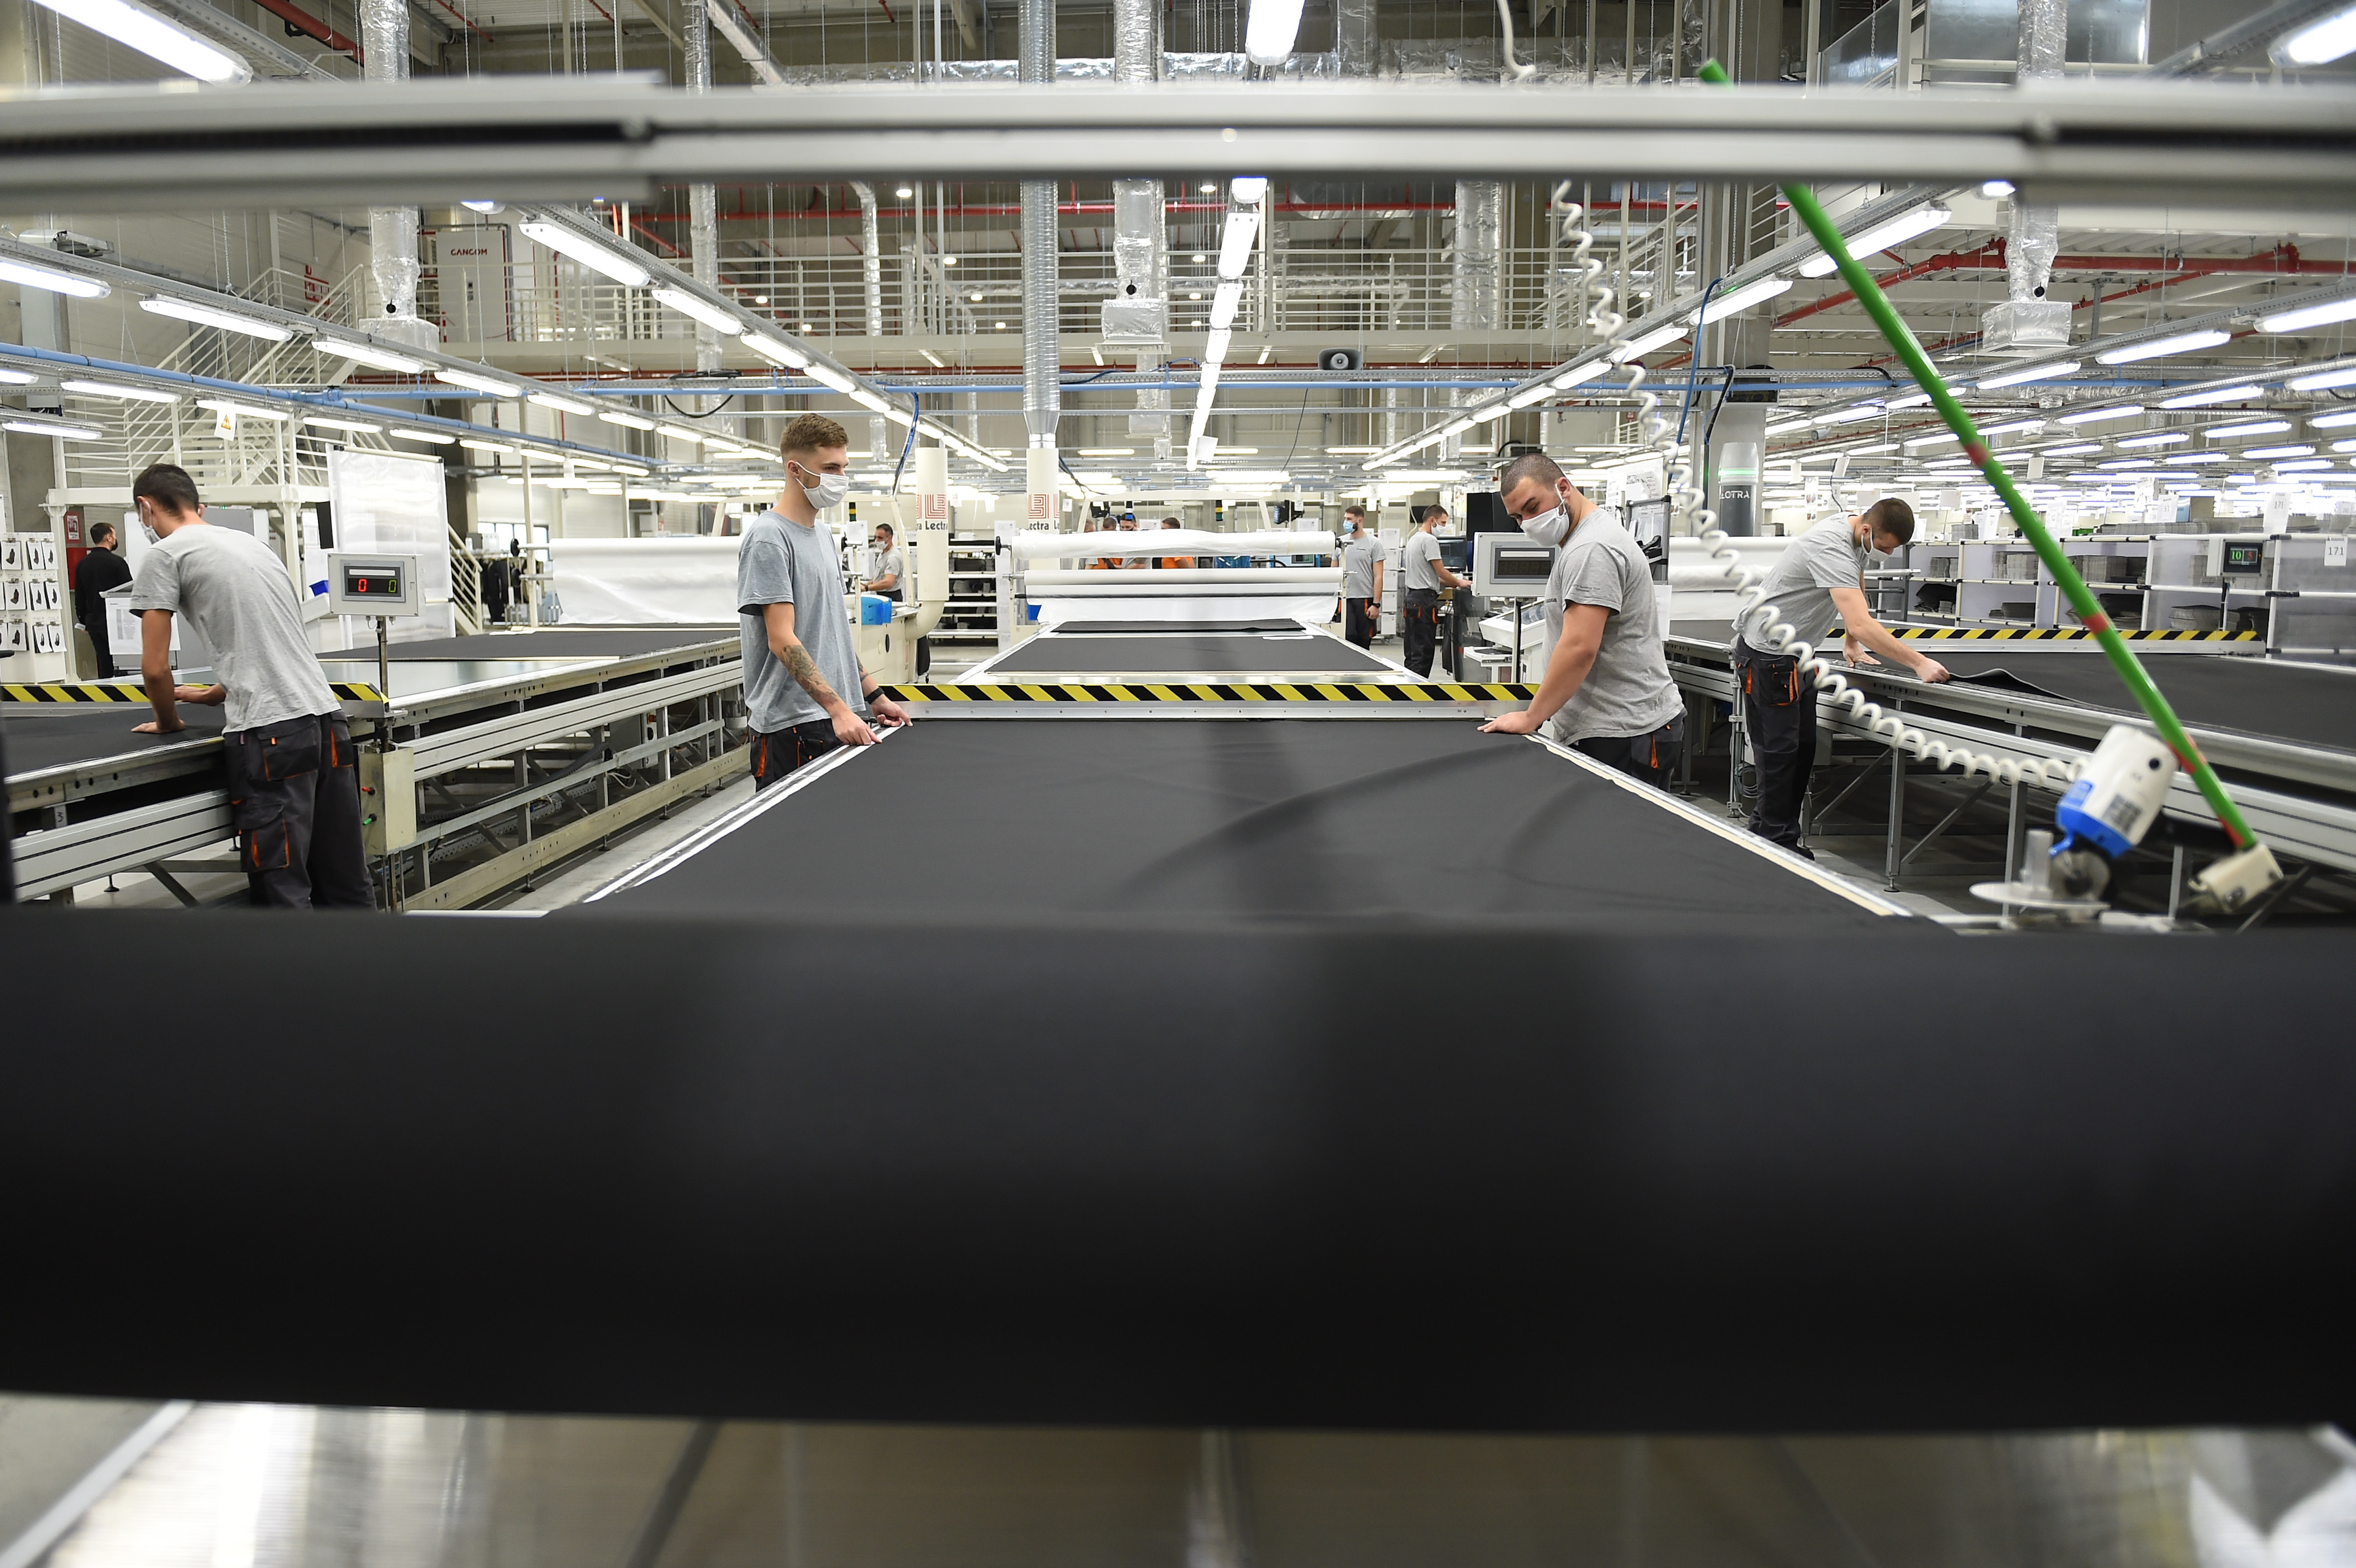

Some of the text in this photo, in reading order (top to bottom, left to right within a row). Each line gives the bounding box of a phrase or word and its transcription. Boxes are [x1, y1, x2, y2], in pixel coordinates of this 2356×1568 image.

[1029, 521, 1049, 530] ectra
[2232, 550, 2242, 560] 10
[2328, 546, 2344, 555] 171
[358, 579, 397, 593] 0 0
